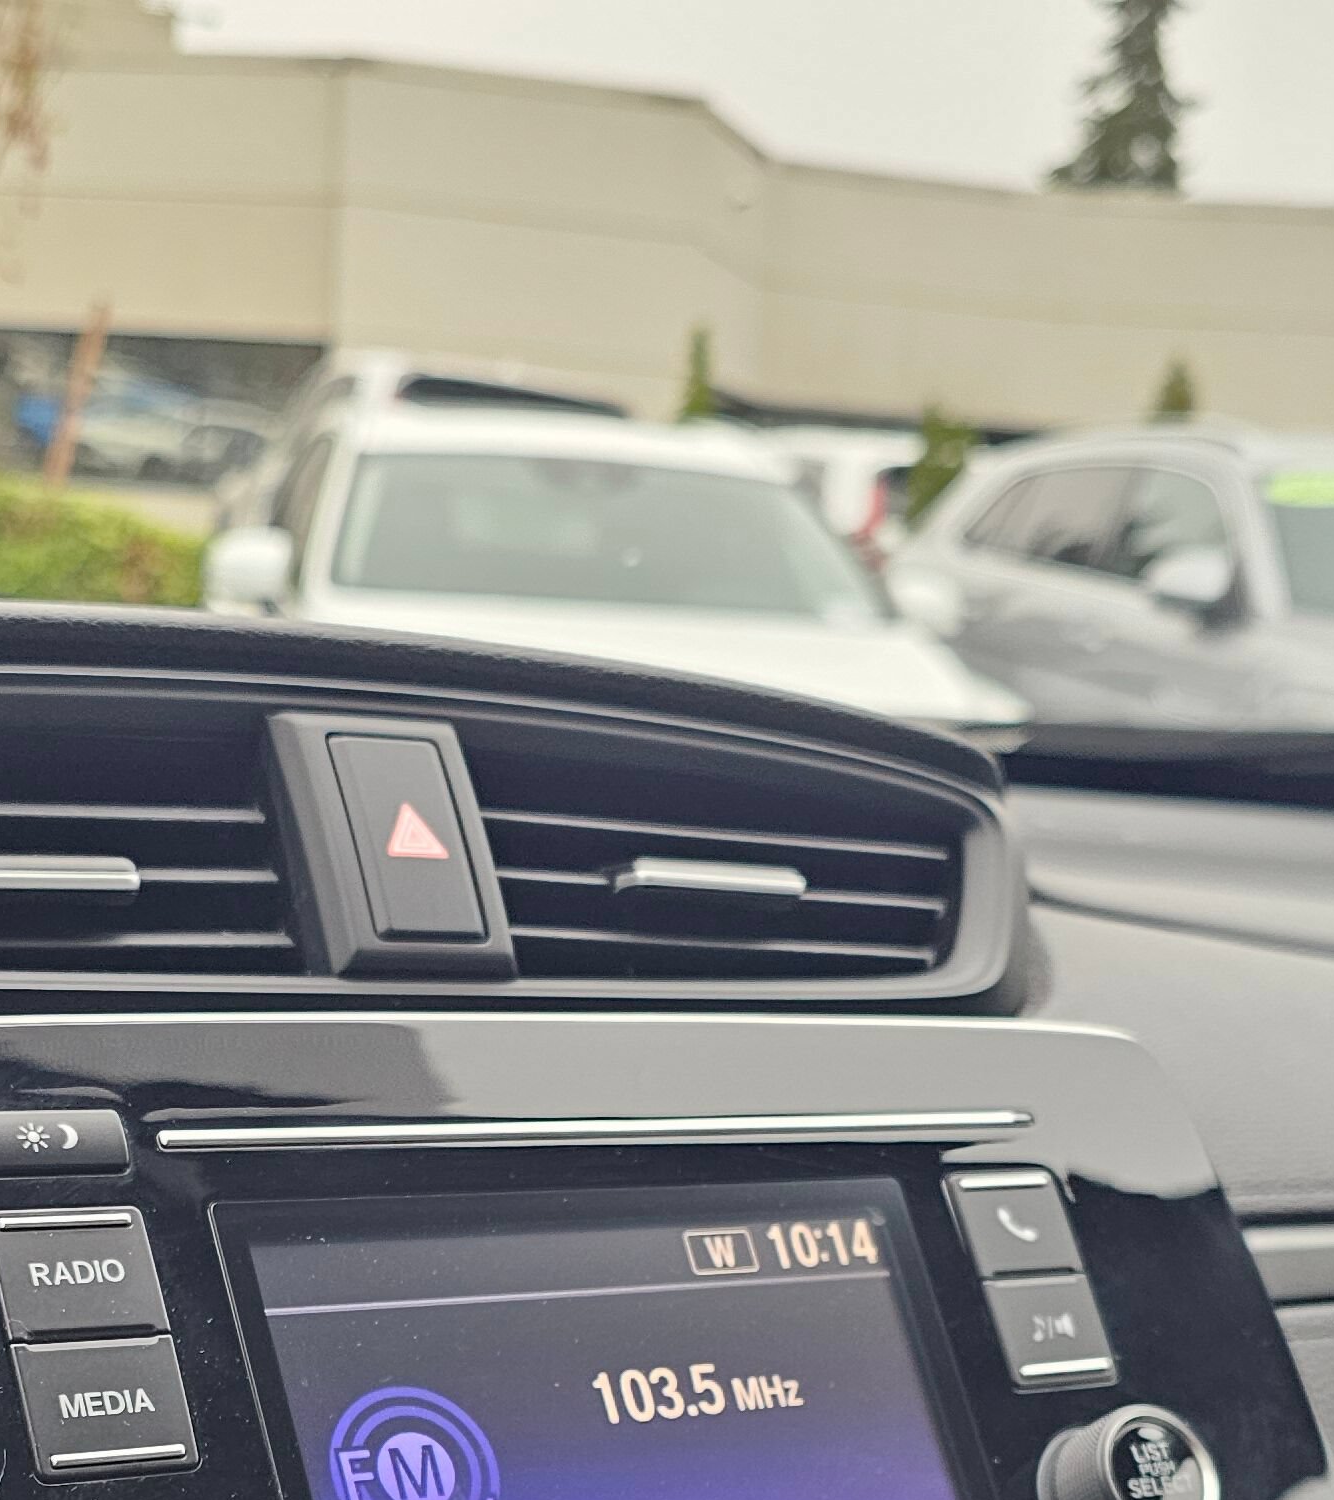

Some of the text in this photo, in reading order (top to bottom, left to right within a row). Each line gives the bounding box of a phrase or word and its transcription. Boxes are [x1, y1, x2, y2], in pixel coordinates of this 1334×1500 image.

[705, 1219, 879, 1269] W 10:14
[28, 1258, 126, 1287] RADIO
[58, 1387, 155, 1420] MEDIA
[592, 1364, 805, 1424] 103.5 MHz
[1130, 1442, 1169, 1463] LIST
[1128, 1476, 1193, 1499] SELECT
